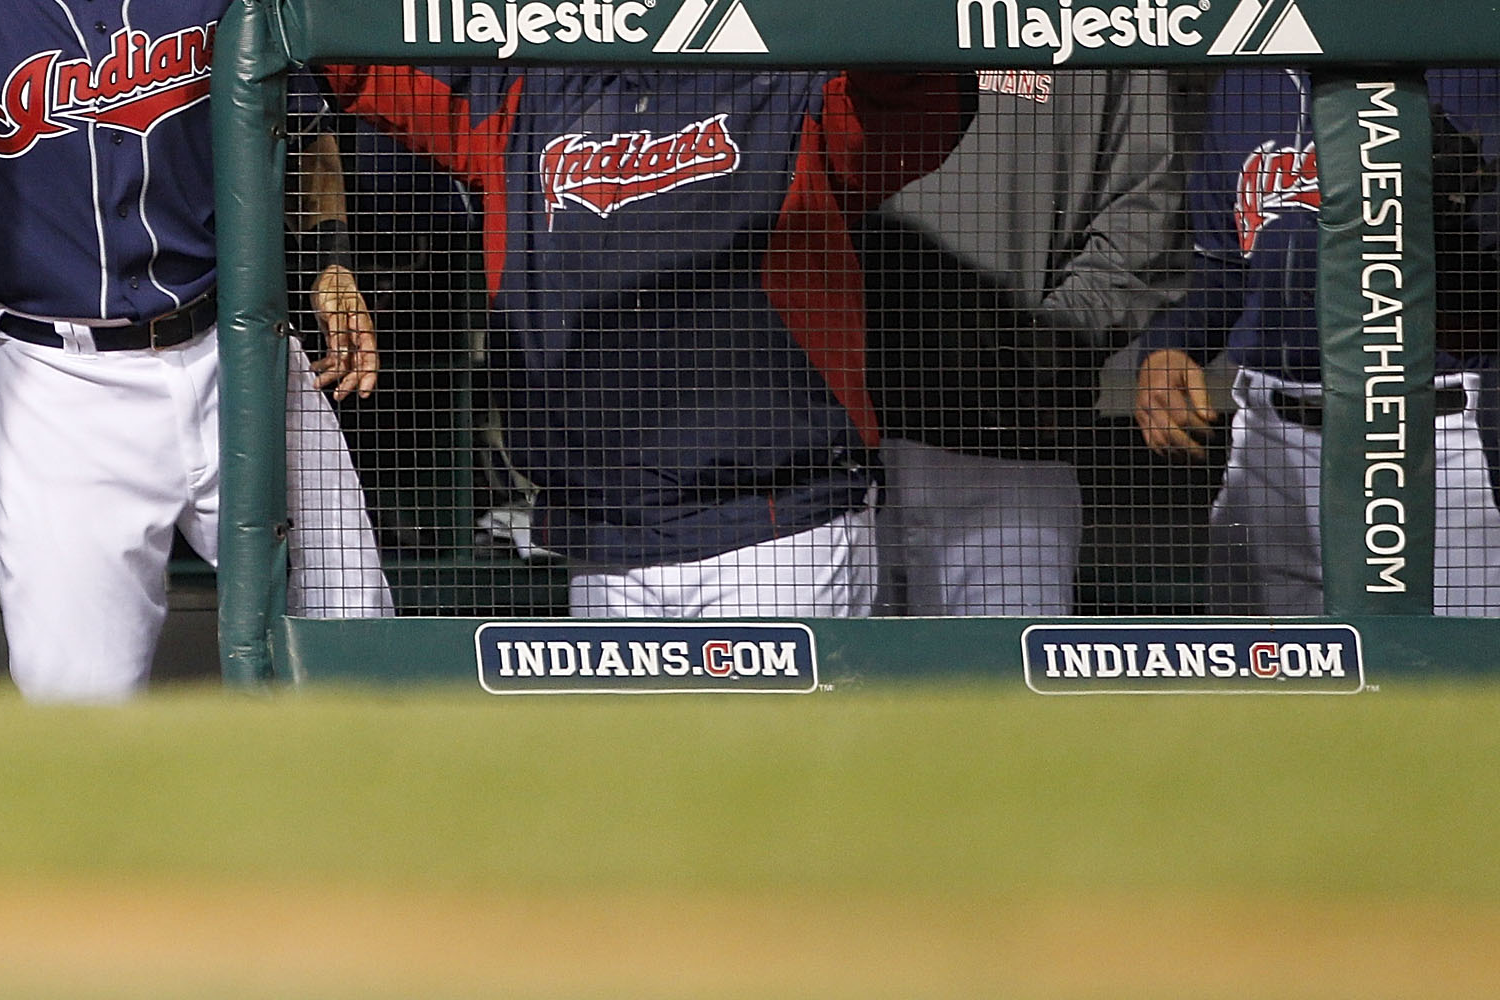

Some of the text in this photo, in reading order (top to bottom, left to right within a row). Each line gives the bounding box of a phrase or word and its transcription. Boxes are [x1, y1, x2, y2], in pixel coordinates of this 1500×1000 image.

[540, 113, 740, 232] Indians
[1356, 82, 1406, 593] MAJESTICATHLETIC.COM
[497, 640, 799, 678] INDIANS.COM
[1043, 642, 1345, 679] INDIANS.COM
